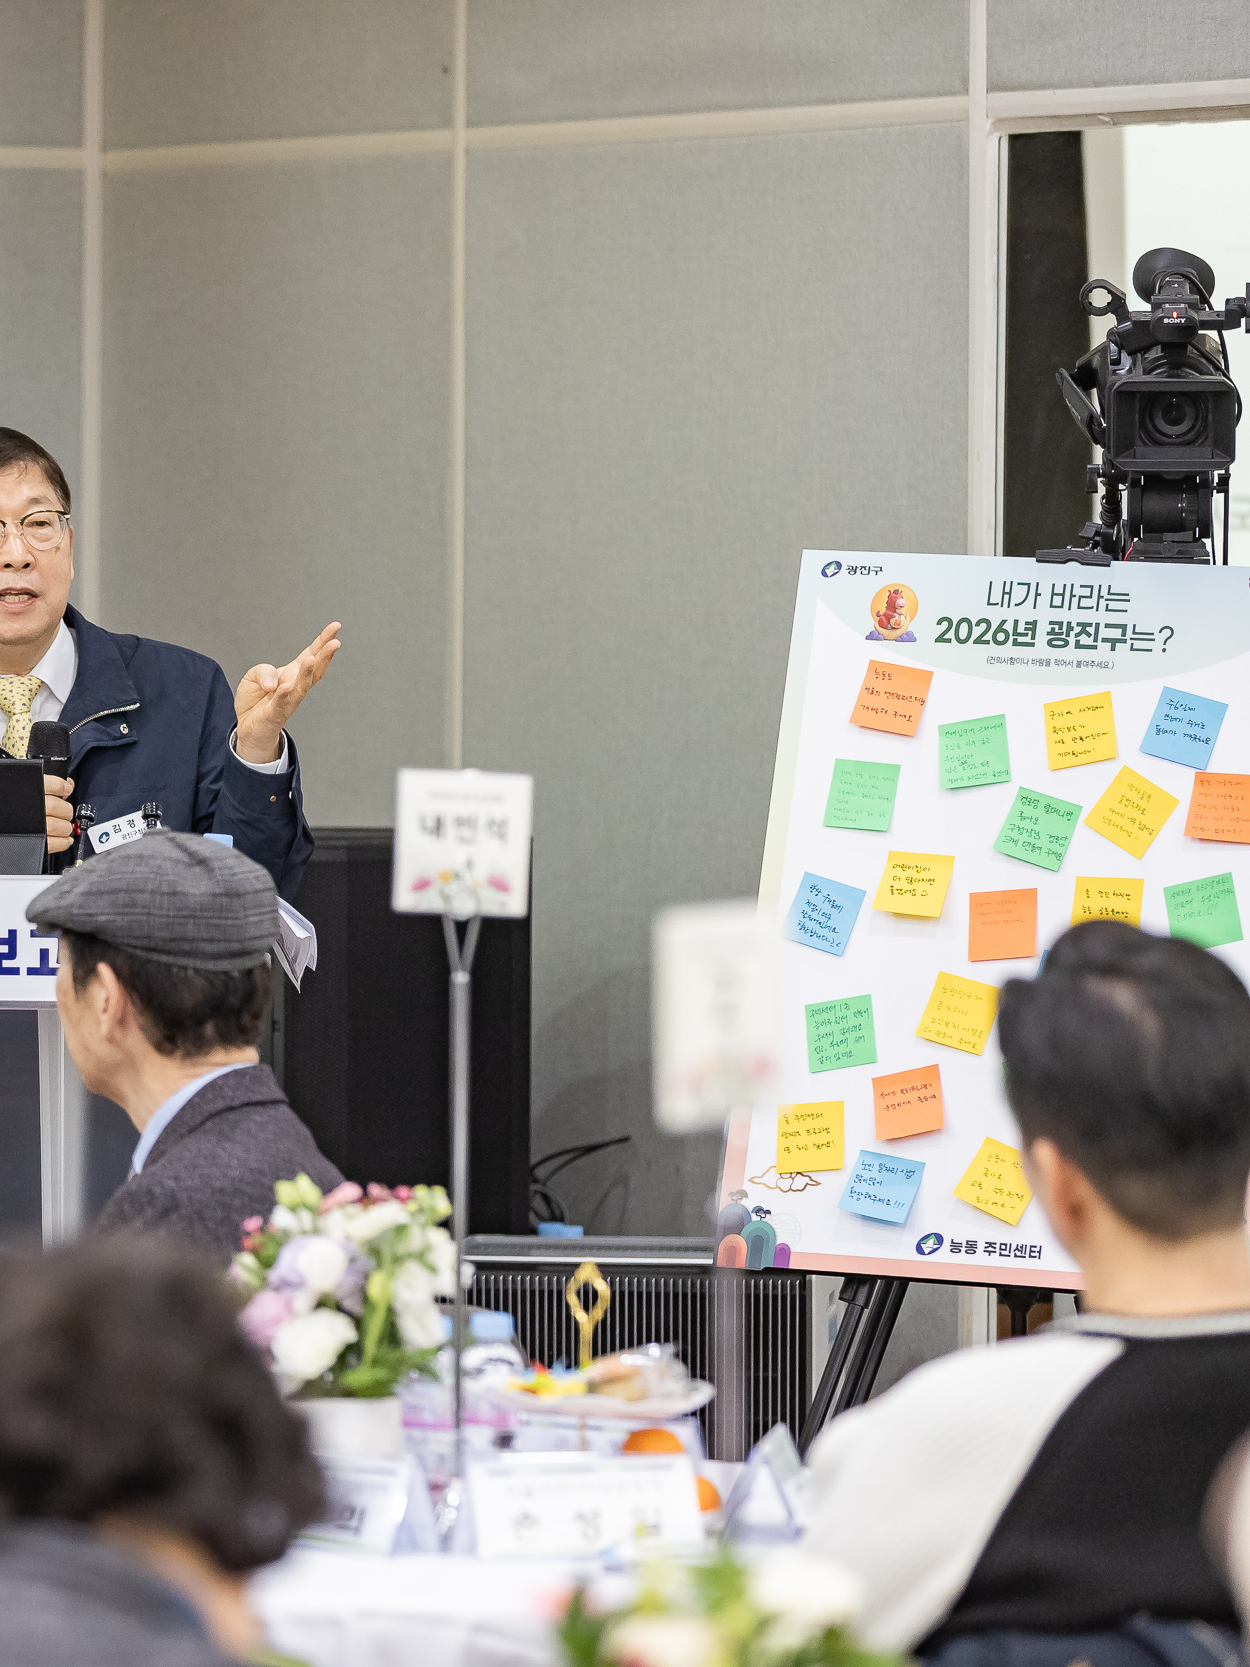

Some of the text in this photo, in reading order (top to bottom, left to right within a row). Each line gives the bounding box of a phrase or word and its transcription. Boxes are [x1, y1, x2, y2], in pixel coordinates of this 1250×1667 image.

[845, 564, 884, 576] 광진구
[986, 580, 1131, 613] 내가 바라는
[935, 616, 1175, 653] 2026년 광진구는?
[986, 655, 1030, 666] (건의사항이나
[1031, 658, 1052, 668] 바람을
[1053, 659, 1074, 668] 적어서
[1020, 795, 1040, 810] 경로당
[892, 863, 931, 874] 어린이집이
[949, 1238, 1043, 1260] 능동 주민센터
